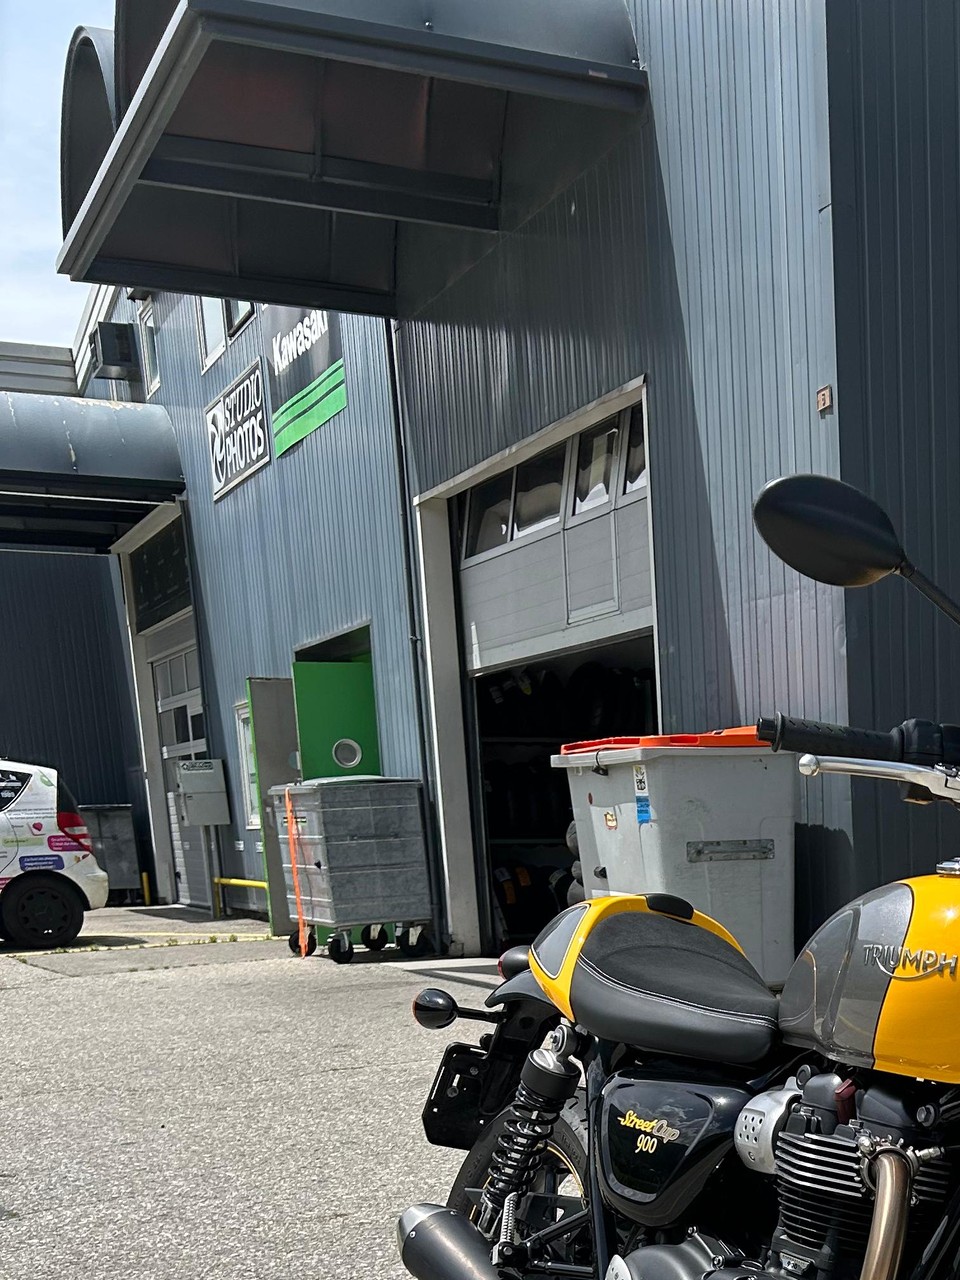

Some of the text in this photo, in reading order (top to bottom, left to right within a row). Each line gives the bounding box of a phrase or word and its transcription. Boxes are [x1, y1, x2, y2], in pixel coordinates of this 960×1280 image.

[272, 309, 329, 376] Kawasaki
[224, 369, 263, 428] STUDIO
[225, 410, 265, 478] PHOTOS
[863, 943, 959, 979] TRIUMPH
[635, 1134, 658, 1153] 900
